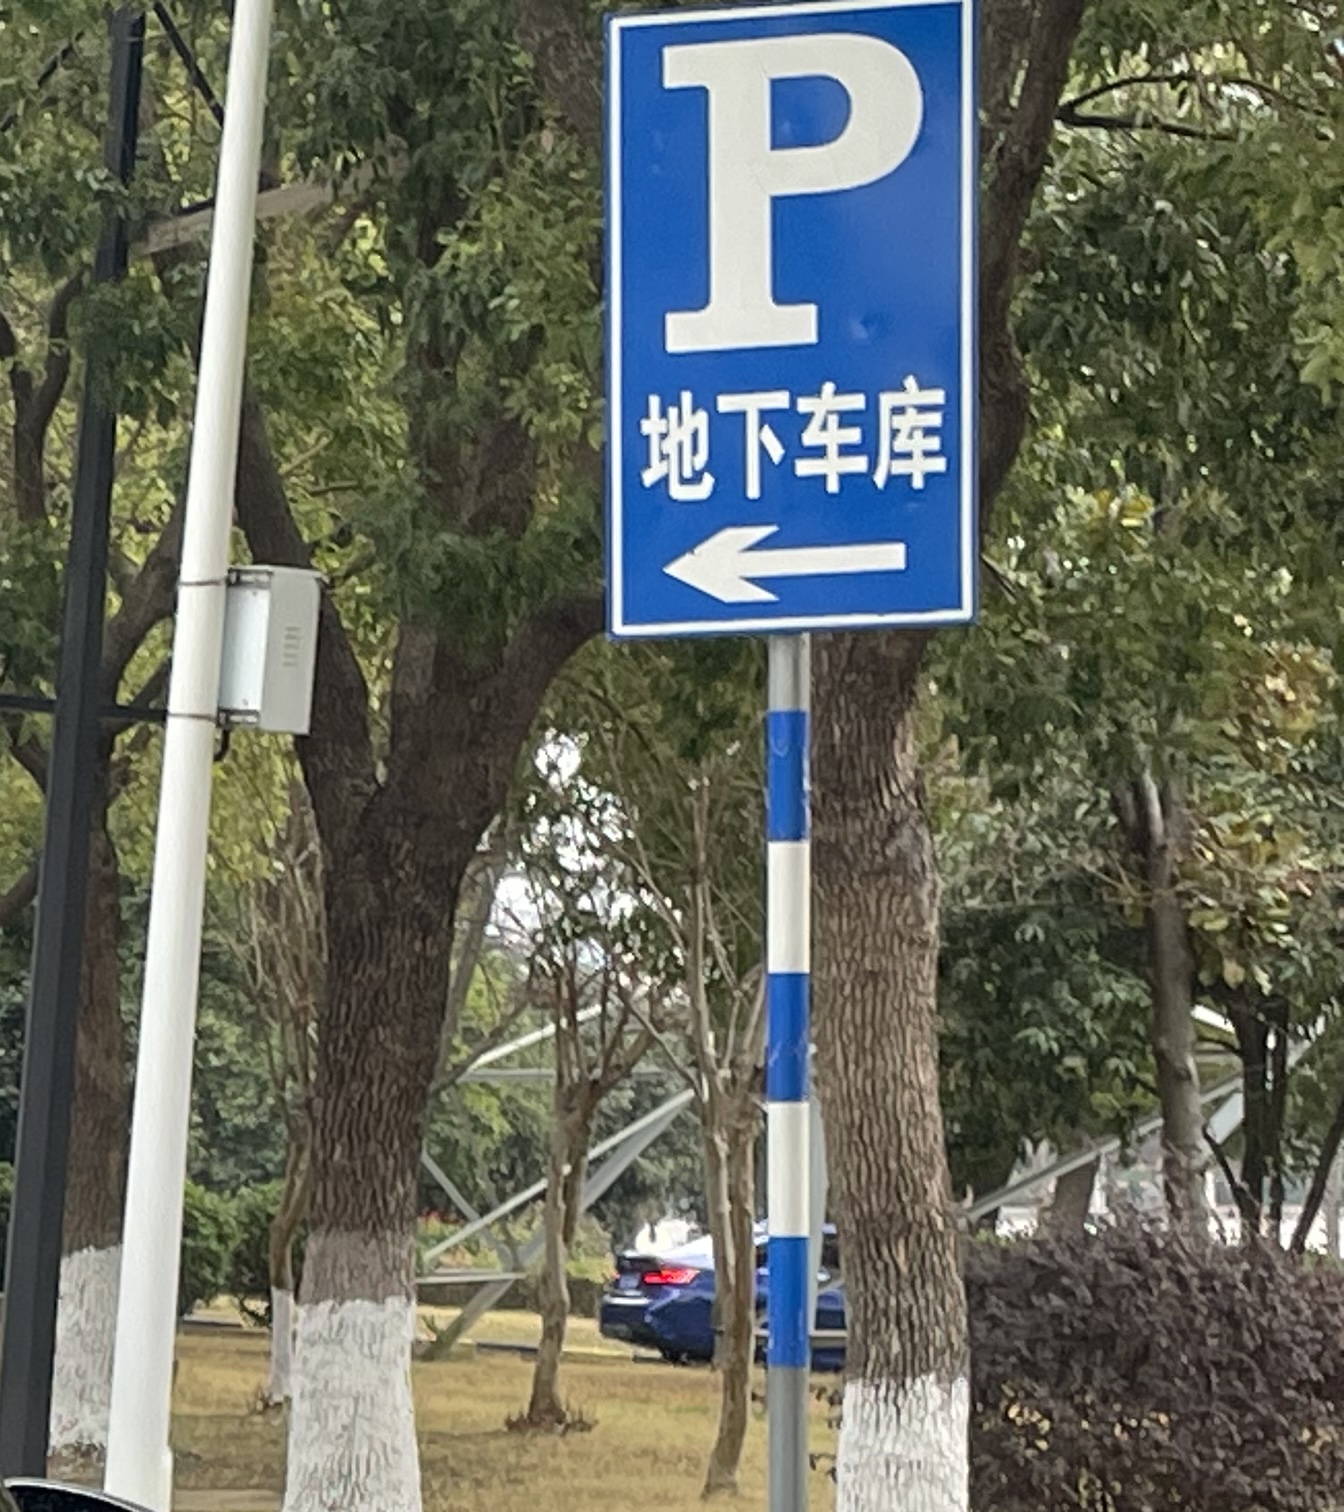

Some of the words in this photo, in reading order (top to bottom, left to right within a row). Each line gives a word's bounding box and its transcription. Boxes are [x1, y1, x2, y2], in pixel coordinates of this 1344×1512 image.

[662, 32, 924, 354] P
[640, 374, 947, 502] 地下车库
